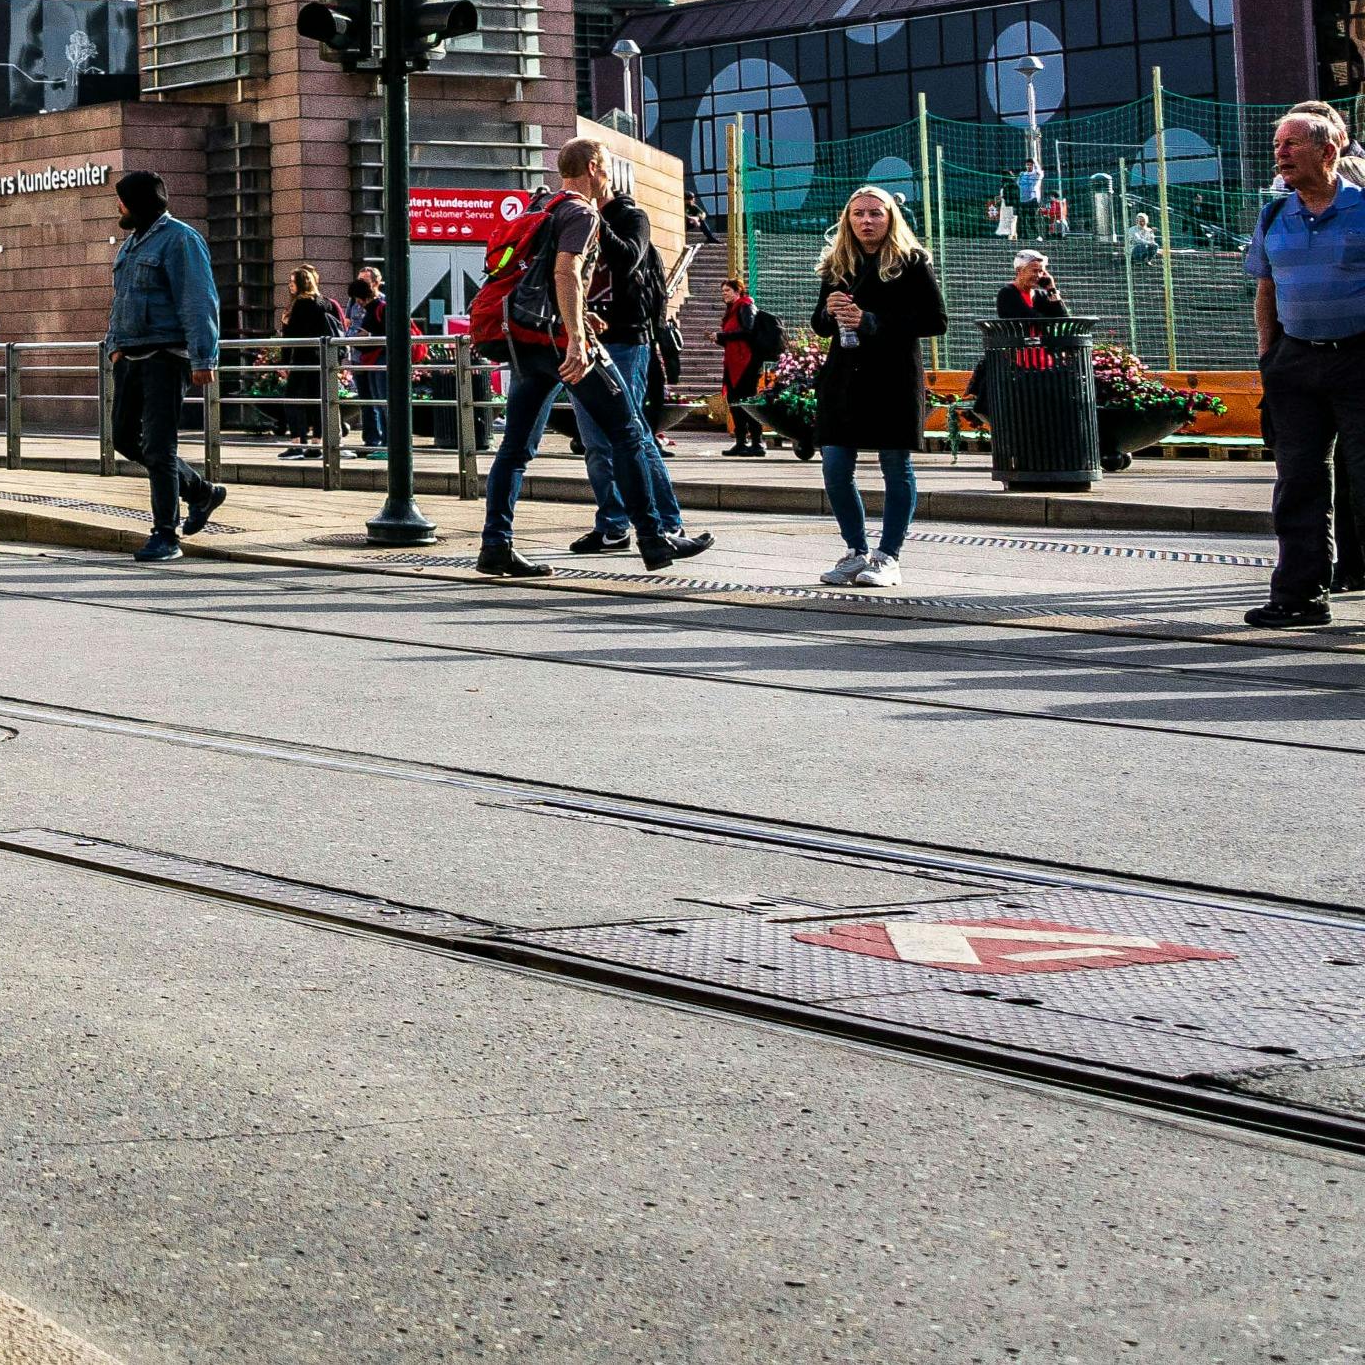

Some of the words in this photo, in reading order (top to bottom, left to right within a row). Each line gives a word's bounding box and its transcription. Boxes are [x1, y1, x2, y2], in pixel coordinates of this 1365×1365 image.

[17, 162, 108, 193] kundesenter
[433, 197, 494, 209] kundesenter
[424, 209, 463, 218] Customer
[465, 209, 495, 219] Service
